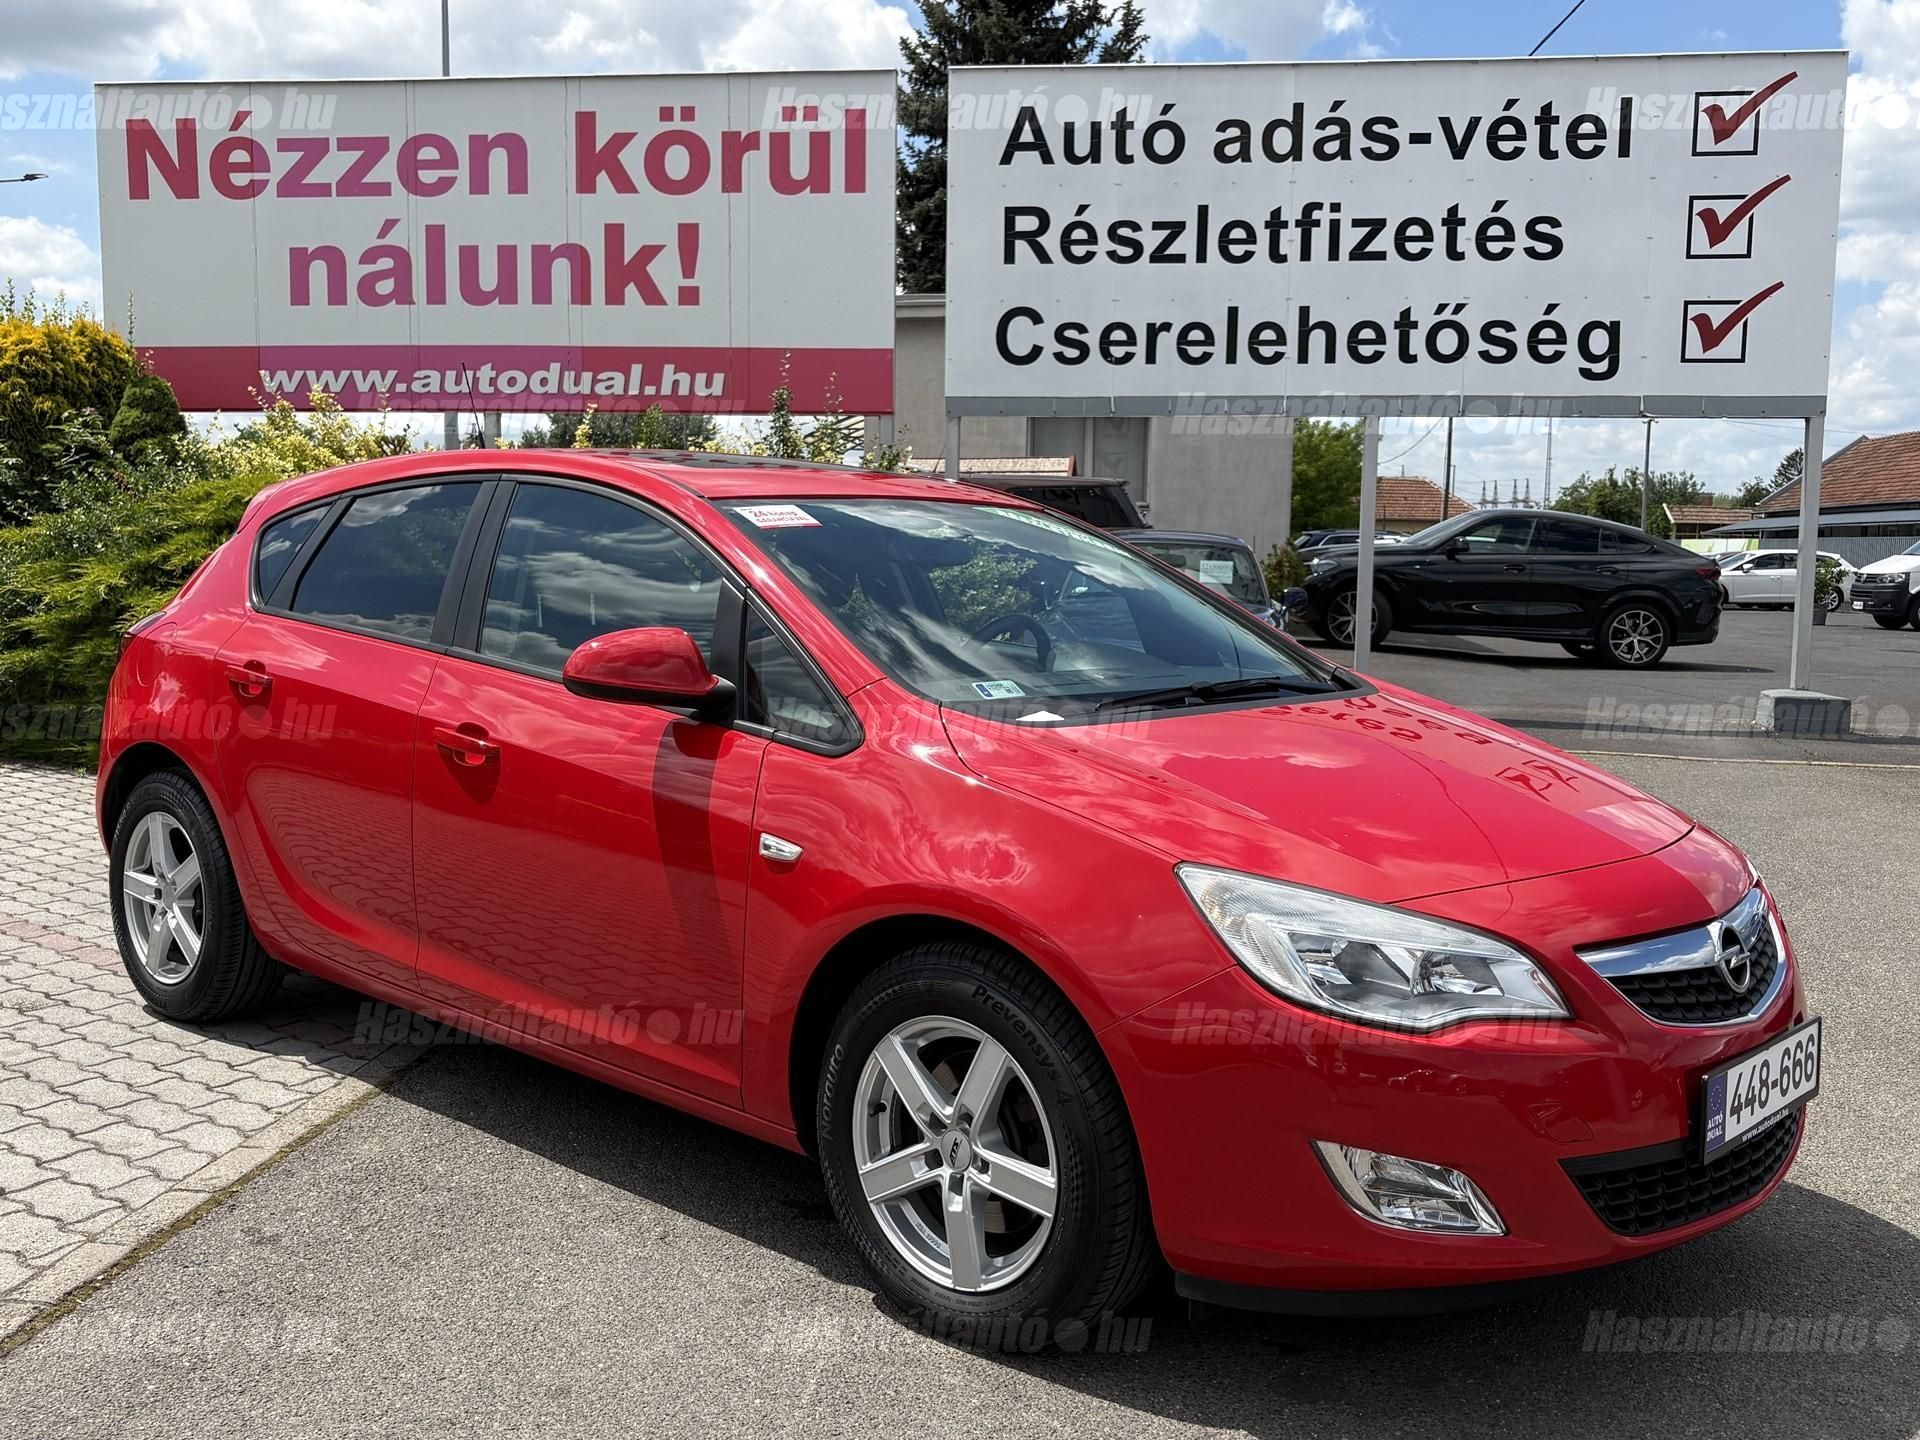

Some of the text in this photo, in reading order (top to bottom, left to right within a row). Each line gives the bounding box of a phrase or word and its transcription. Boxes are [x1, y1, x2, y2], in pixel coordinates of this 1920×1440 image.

[126, 105, 867, 201] Nézzen körül
[1000, 96, 1633, 166] Autó adás-vétel
[289, 218, 700, 307] nálunk!
[1003, 199, 1565, 265] Részletfizetés
[259, 362, 725, 397] www.autodual.hu
[995, 302, 1621, 382] Cserelehetőség
[970, 983, 1062, 1085] Prevensys
[821, 1042, 845, 1141] Norauto
[1728, 1033, 1815, 1125] 448-666
[1706, 1111, 1724, 1130] AUTÓ
[1706, 1127, 1724, 1143] DUAL
[1741, 1107, 1790, 1142] www.autodual.hu
